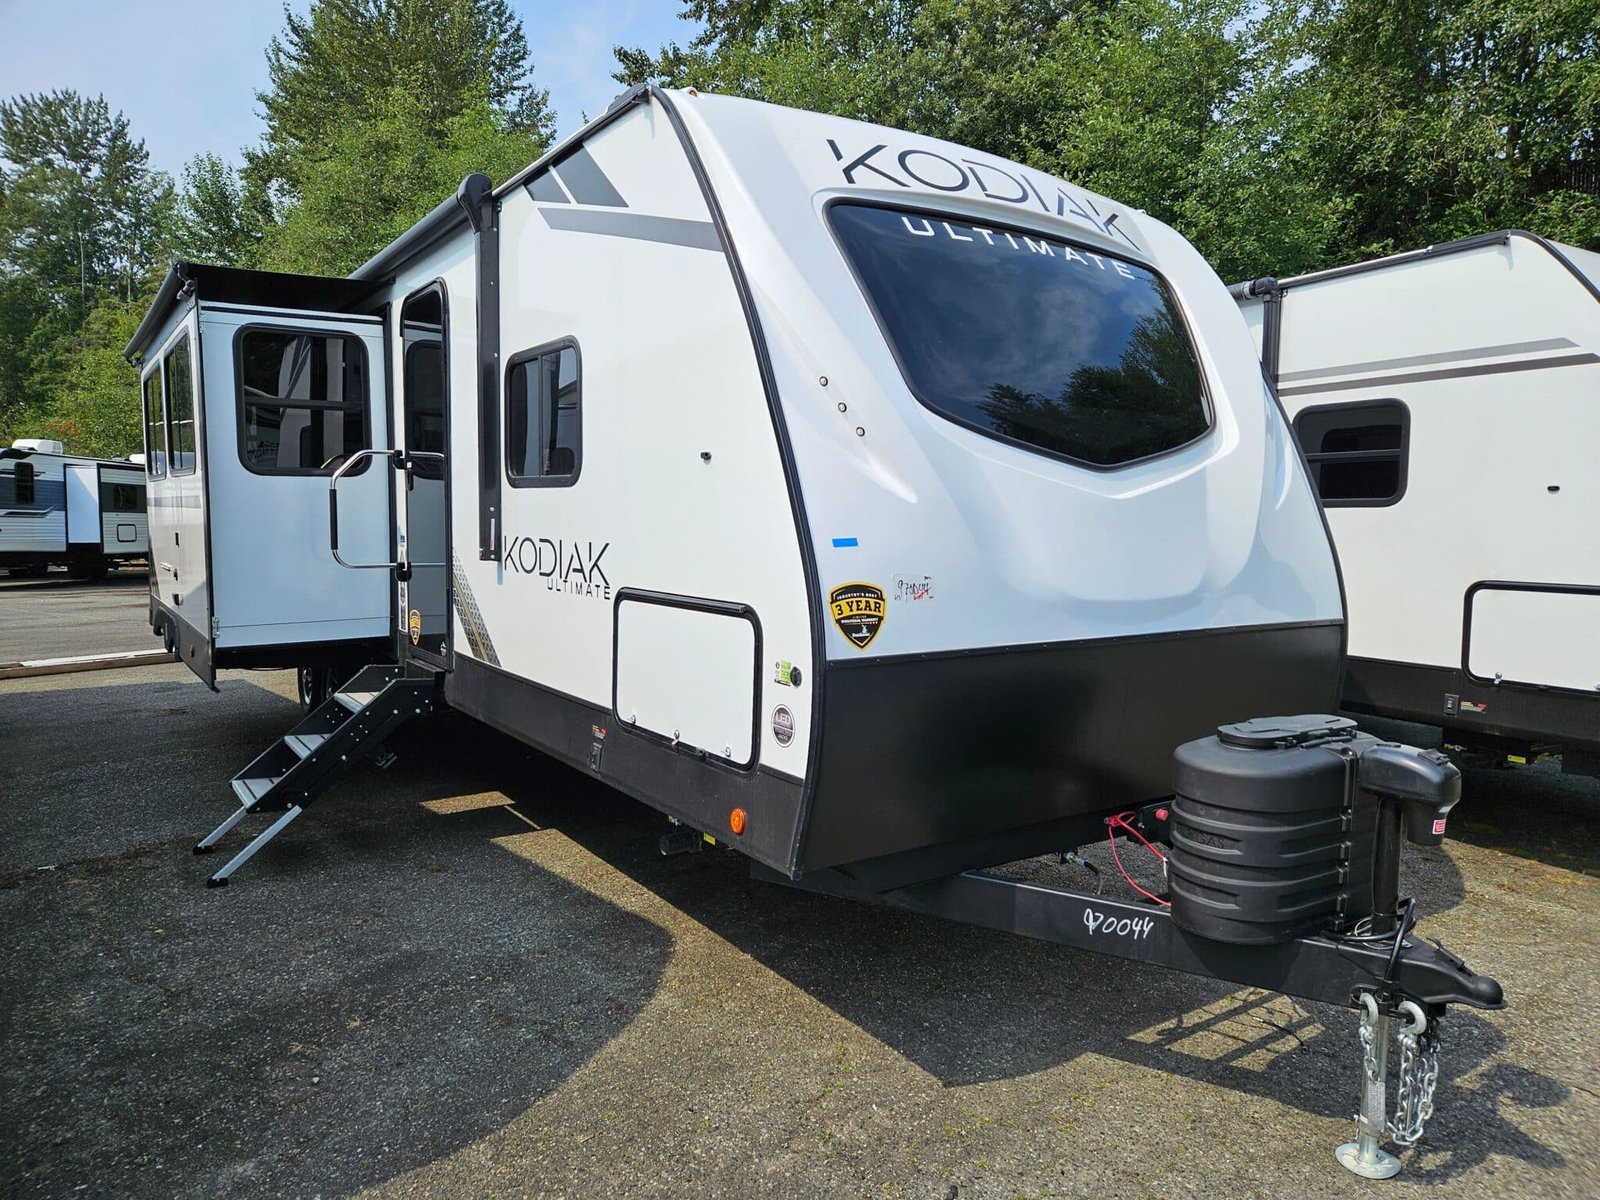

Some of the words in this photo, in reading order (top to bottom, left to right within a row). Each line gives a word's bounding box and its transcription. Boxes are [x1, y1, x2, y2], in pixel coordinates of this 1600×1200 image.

[826, 139, 1142, 252] KODIAK
[901, 216, 1136, 280] ULTIMATE
[503, 535, 610, 586] KODIAK
[546, 578, 611, 600] ULTIMATE
[834, 603, 844, 616] 3
[846, 599, 882, 613] YEAR
[775, 711, 791, 725] LED
[1083, 908, 1154, 940] 970044
